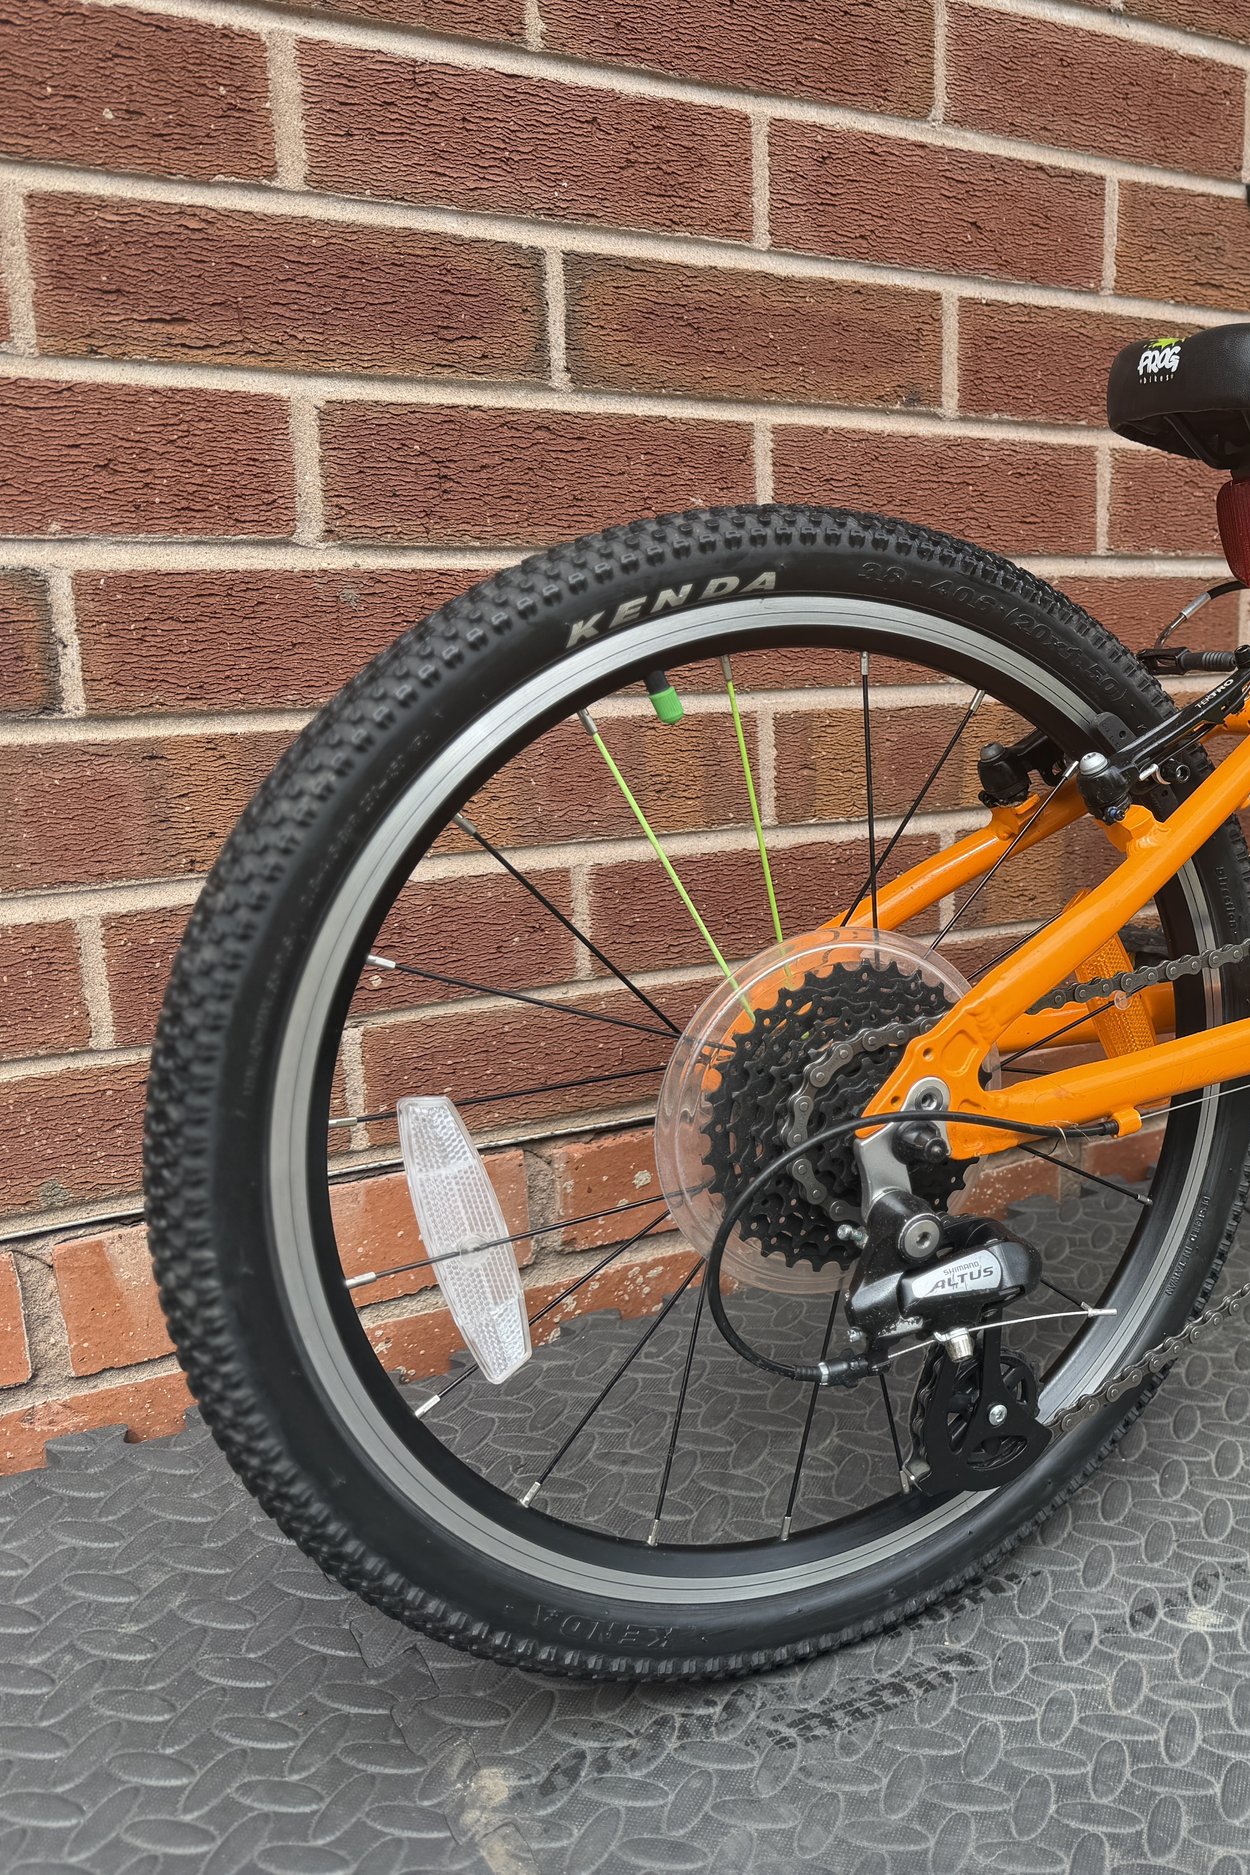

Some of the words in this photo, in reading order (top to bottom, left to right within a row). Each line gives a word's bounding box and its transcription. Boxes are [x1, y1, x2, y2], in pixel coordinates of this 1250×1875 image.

[1137, 346, 1181, 375] FROG
[566, 571, 777, 648] KENDA
[1195, 678, 1234, 709] TEKTRO
[923, 1266, 994, 1297] ALTUS
[943, 1260, 981, 1276] SHIMANO
